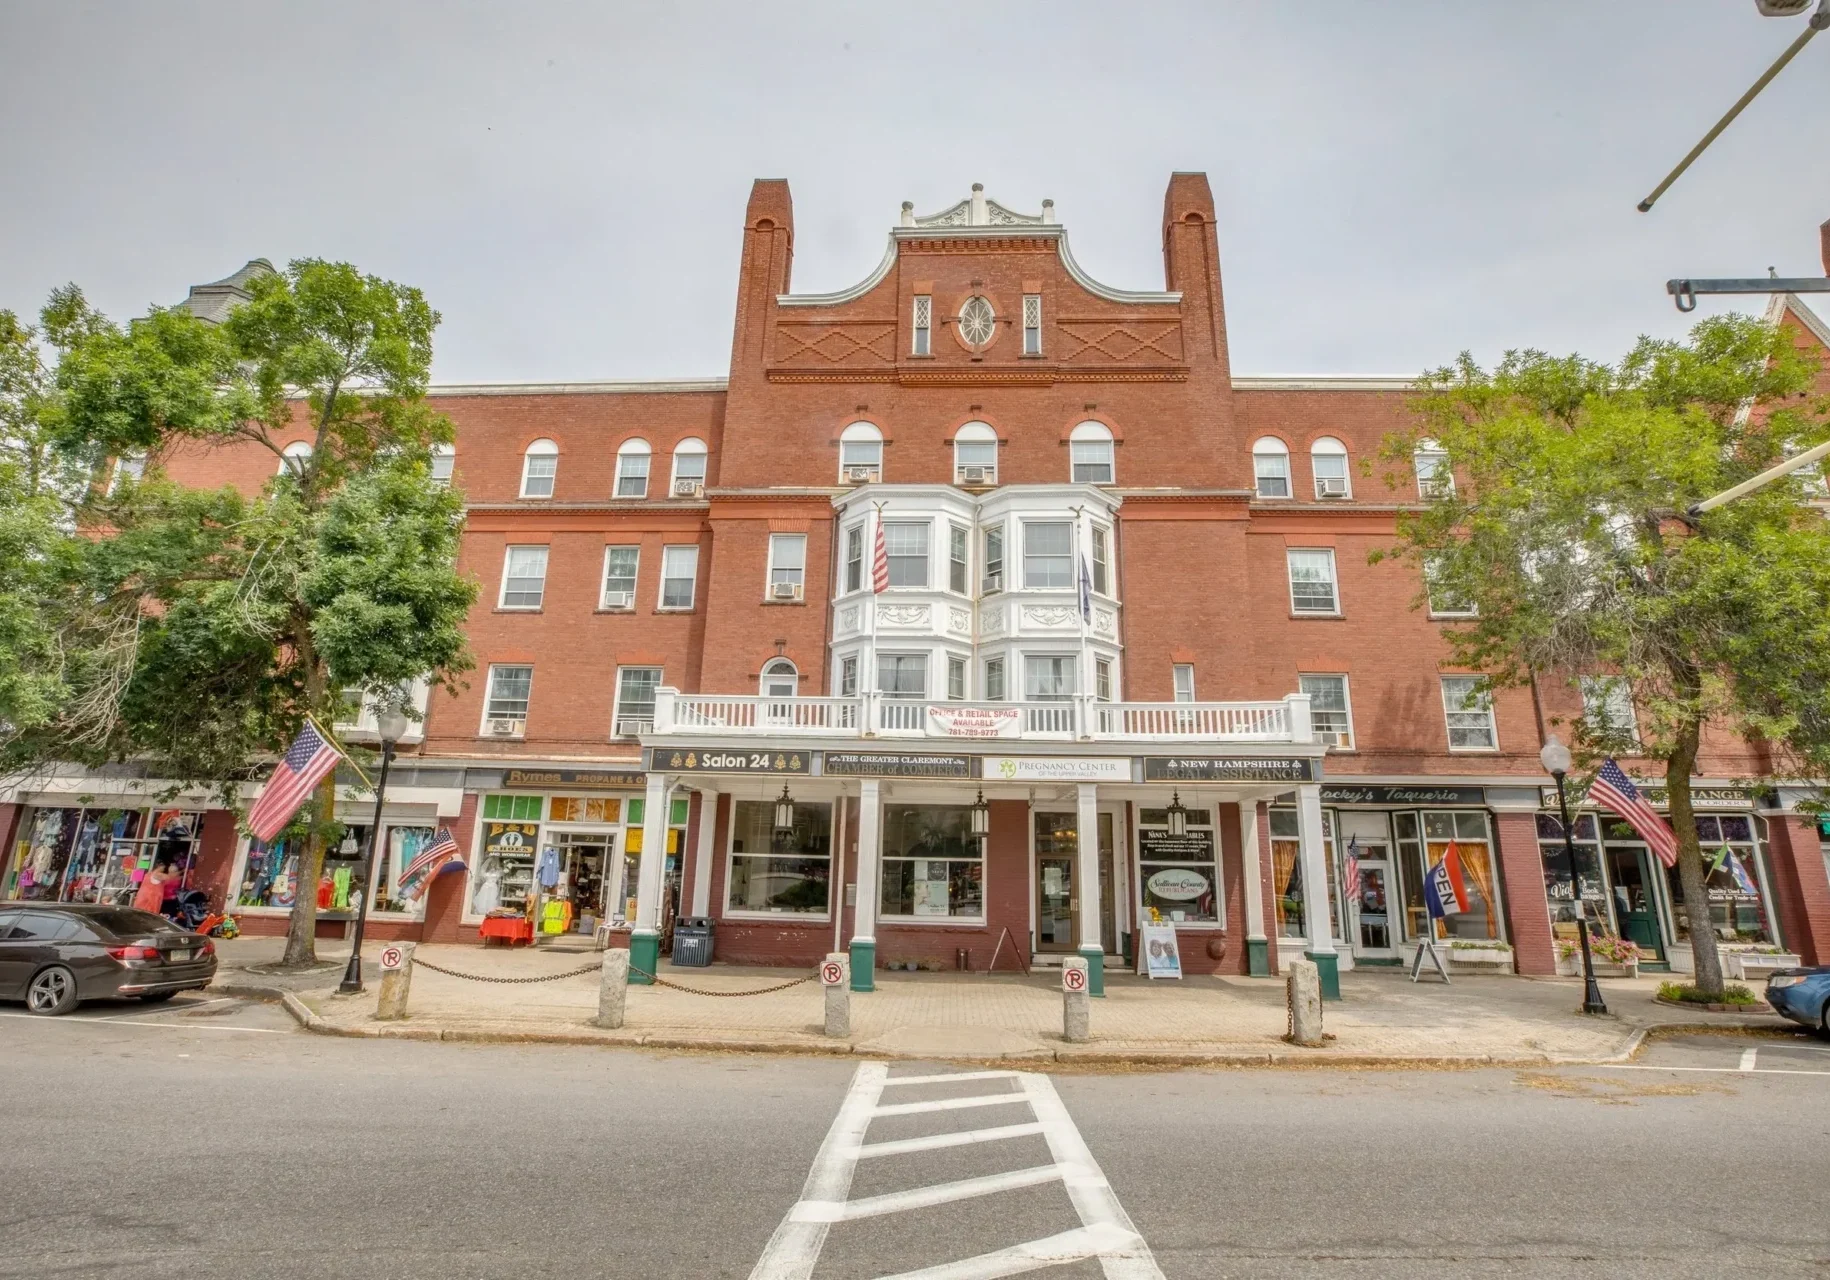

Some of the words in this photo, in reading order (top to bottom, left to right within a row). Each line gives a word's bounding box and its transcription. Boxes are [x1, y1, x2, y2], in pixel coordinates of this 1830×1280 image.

[966, 710, 992, 718] RETAIL
[953, 719, 994, 727] AVAILABLE
[702, 754, 746, 769] Salon
[750, 754, 770, 769] 24
[841, 755, 858, 763] THE
[860, 755, 899, 764] GREATER
[901, 757, 953, 766] CLAREMONT
[1214, 761, 1290, 769] HAMPSHIRE
[827, 763, 884, 775] CHAMBER
[888, 765, 899, 775] of
[902, 765, 968, 777] COMMERCE
[1157, 768, 1206, 779] LEGAL
[1211, 769, 1302, 780] ASSISTANCE
[510, 771, 561, 782] Rymes
[576, 774, 624, 783] PROPANE
[1320, 788, 1373, 802] ocky's
[1384, 787, 1459, 802] Taqueria
[1151, 878, 1180, 889] Sullivan
[1180, 878, 1205, 890] County
[1436, 866, 1456, 906] PEN
